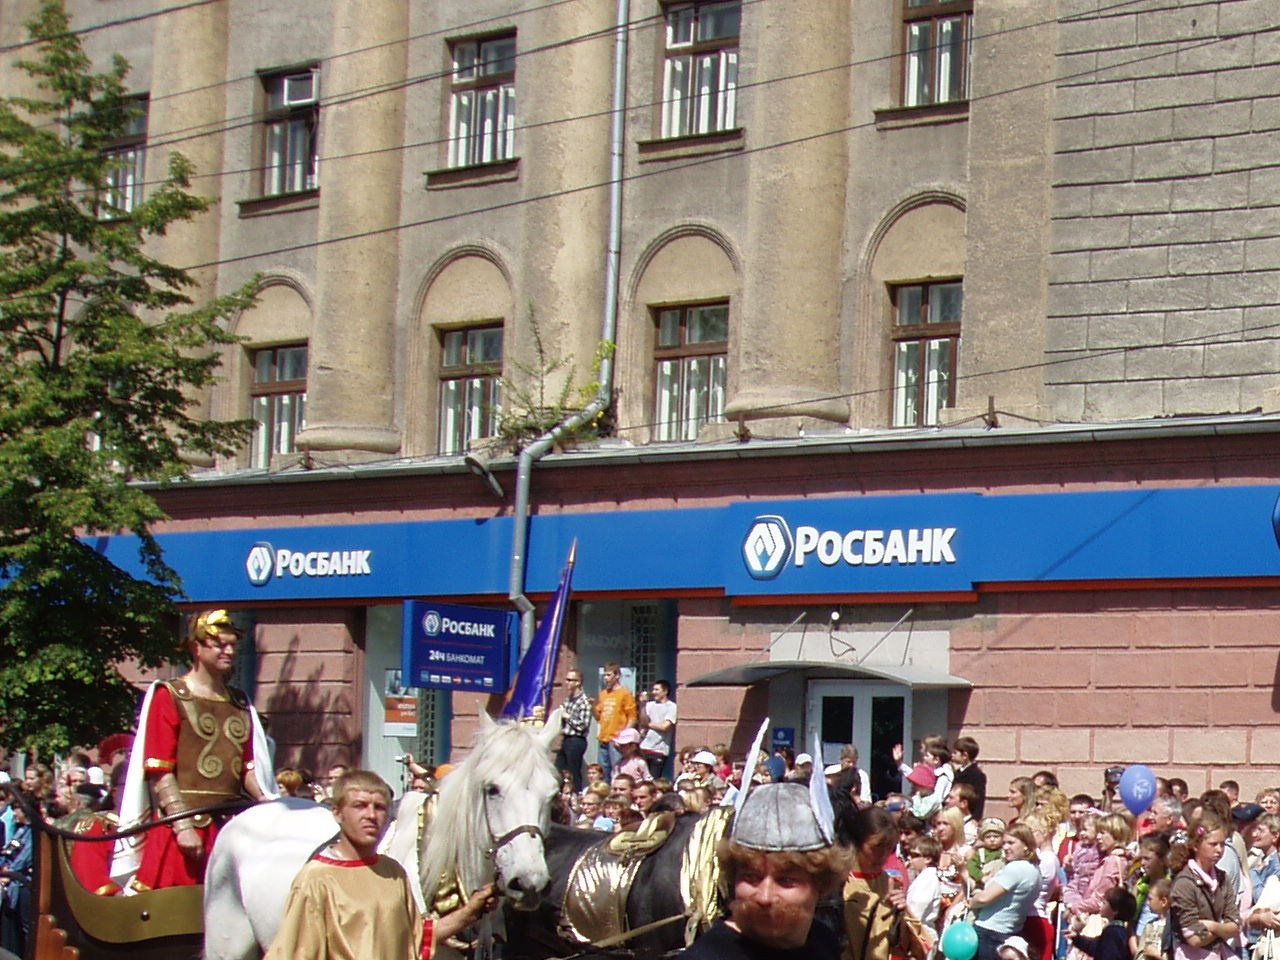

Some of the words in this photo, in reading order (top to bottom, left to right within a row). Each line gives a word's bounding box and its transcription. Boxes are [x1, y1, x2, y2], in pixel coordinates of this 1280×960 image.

[794, 525, 957, 567] РОСБАНК
[276, 549, 371, 577] РОСБАНК
[441, 618, 495, 638] РОСБАНК
[446, 653, 485, 664] БАНКОМАТ
